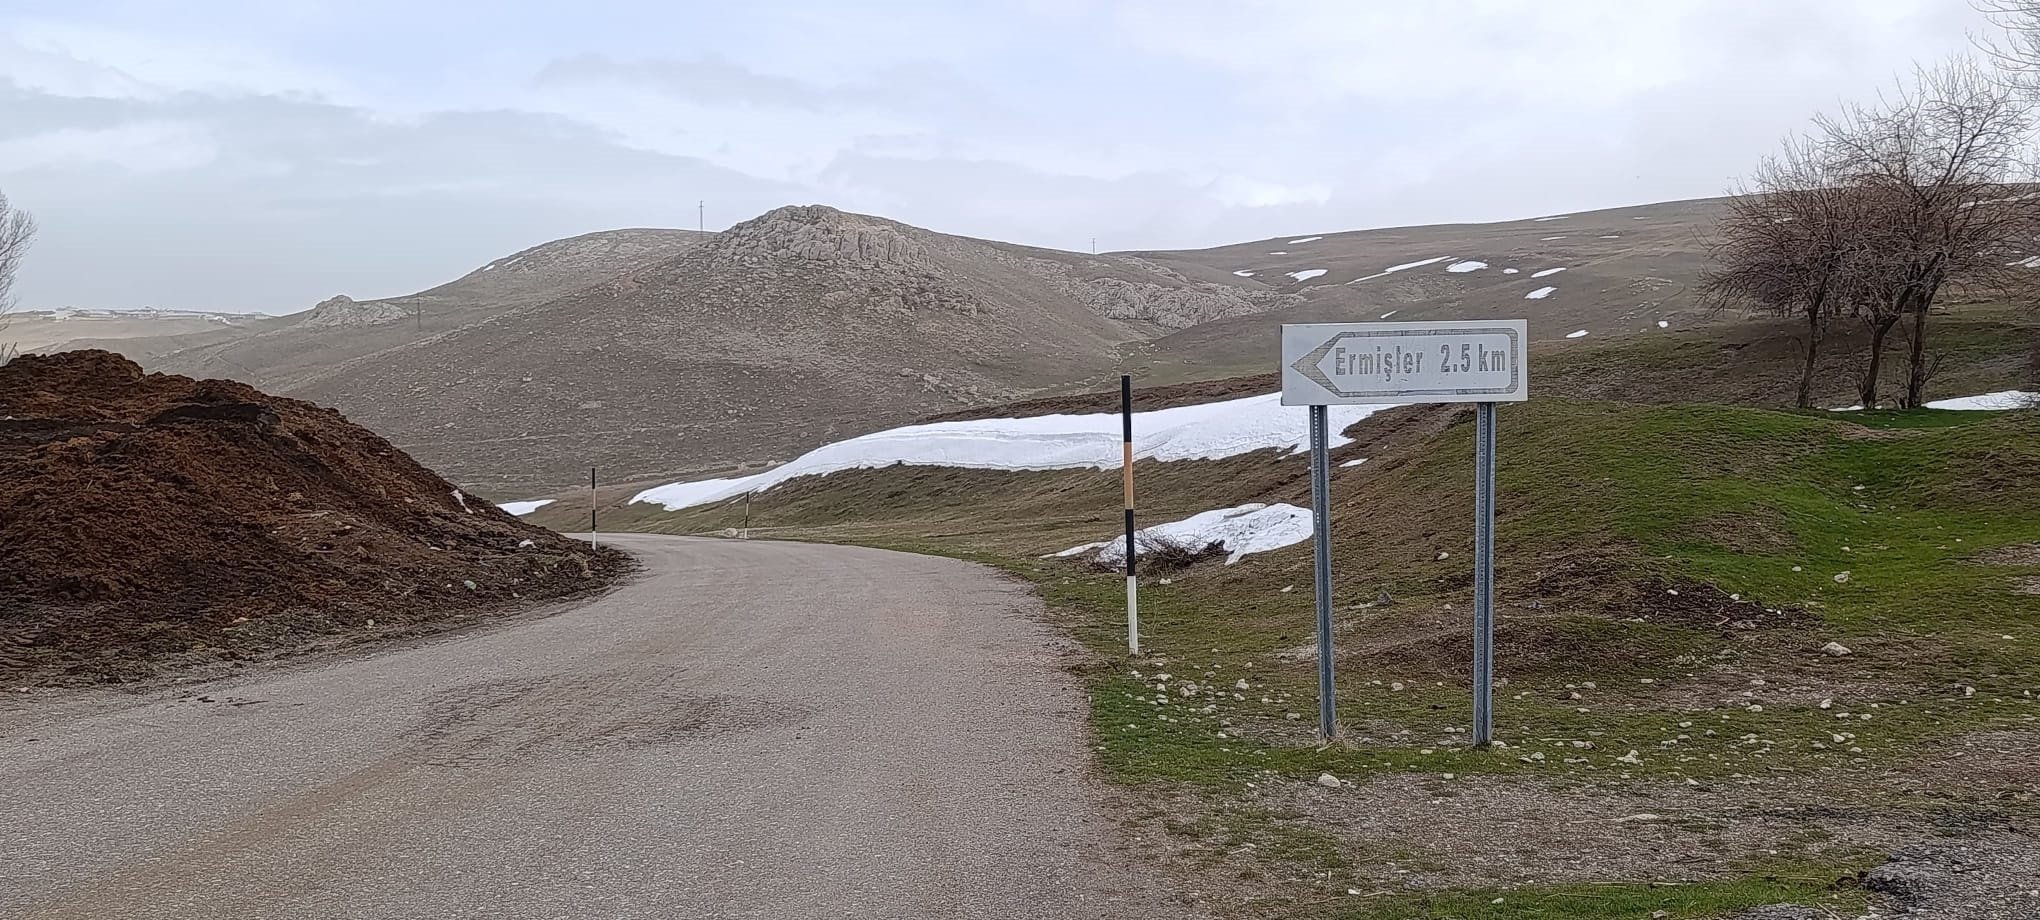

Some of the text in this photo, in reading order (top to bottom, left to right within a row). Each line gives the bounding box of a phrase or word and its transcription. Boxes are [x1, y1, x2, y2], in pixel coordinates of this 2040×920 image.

[1335, 343, 1506, 382] Ermişler 2.5 km
